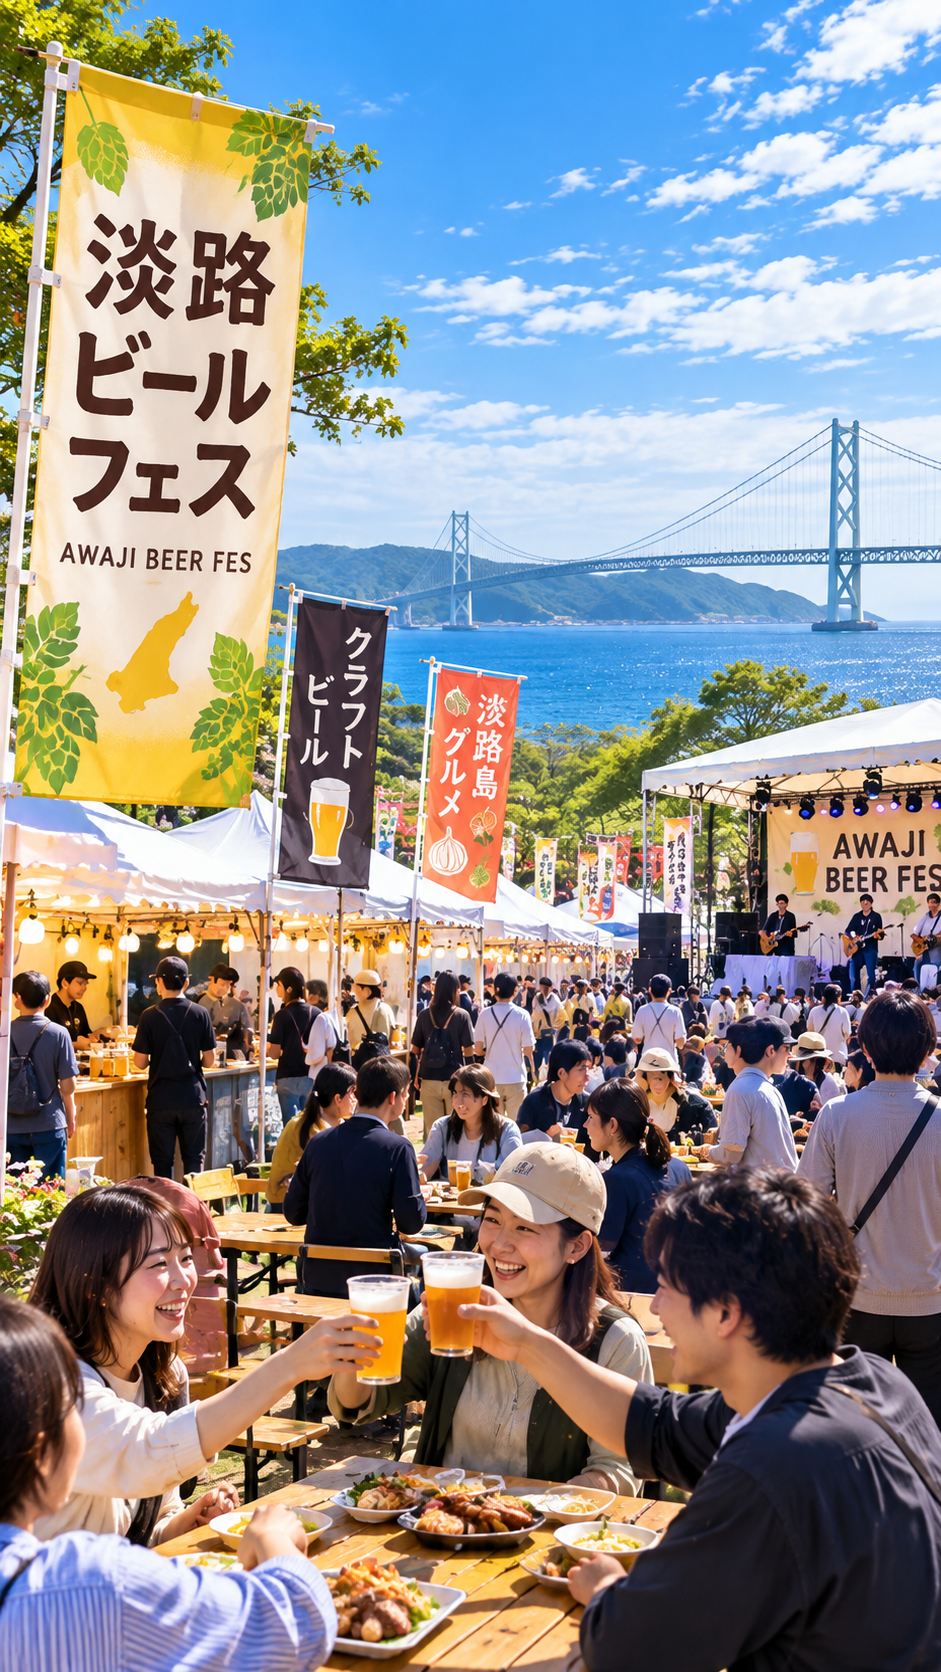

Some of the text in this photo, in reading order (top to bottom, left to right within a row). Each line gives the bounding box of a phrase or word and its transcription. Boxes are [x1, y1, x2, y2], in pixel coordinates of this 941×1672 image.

[86, 213, 275, 326] 淡路
[76, 331, 272, 424] ビール
[69, 437, 256, 520] フェス
[60, 542, 252, 574] AWAJI BEER FES
[299, 673, 335, 767] ビール
[341, 626, 373, 770] クラフト
[438, 727, 471, 818] グルメ
[472, 693, 508, 801] 淡路島
[825, 864, 941, 893] BEER FES
[832, 829, 926, 860] AWAJI
